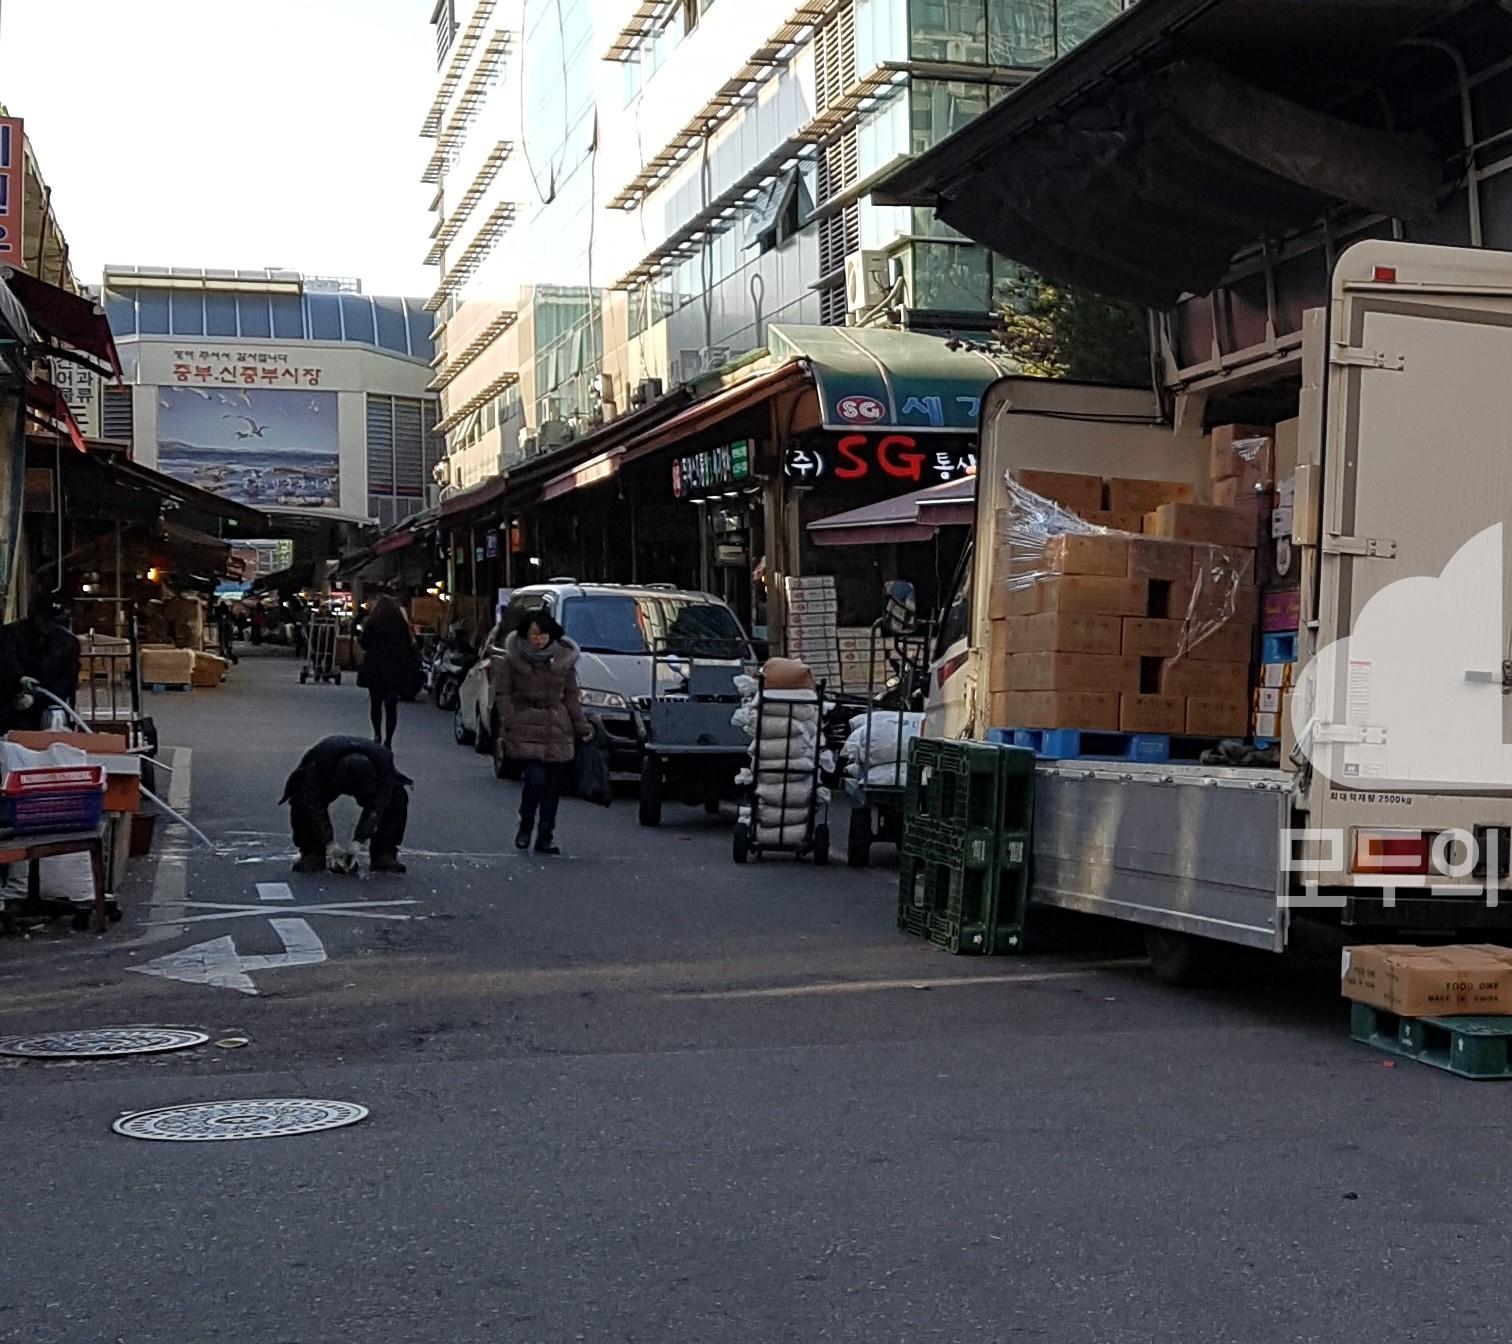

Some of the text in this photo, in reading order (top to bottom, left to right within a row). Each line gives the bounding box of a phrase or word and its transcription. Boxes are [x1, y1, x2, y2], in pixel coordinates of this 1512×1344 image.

[842, 400, 881, 418] SG
[784, 449, 825, 477] (주)
[834, 434, 927, 482] SG
